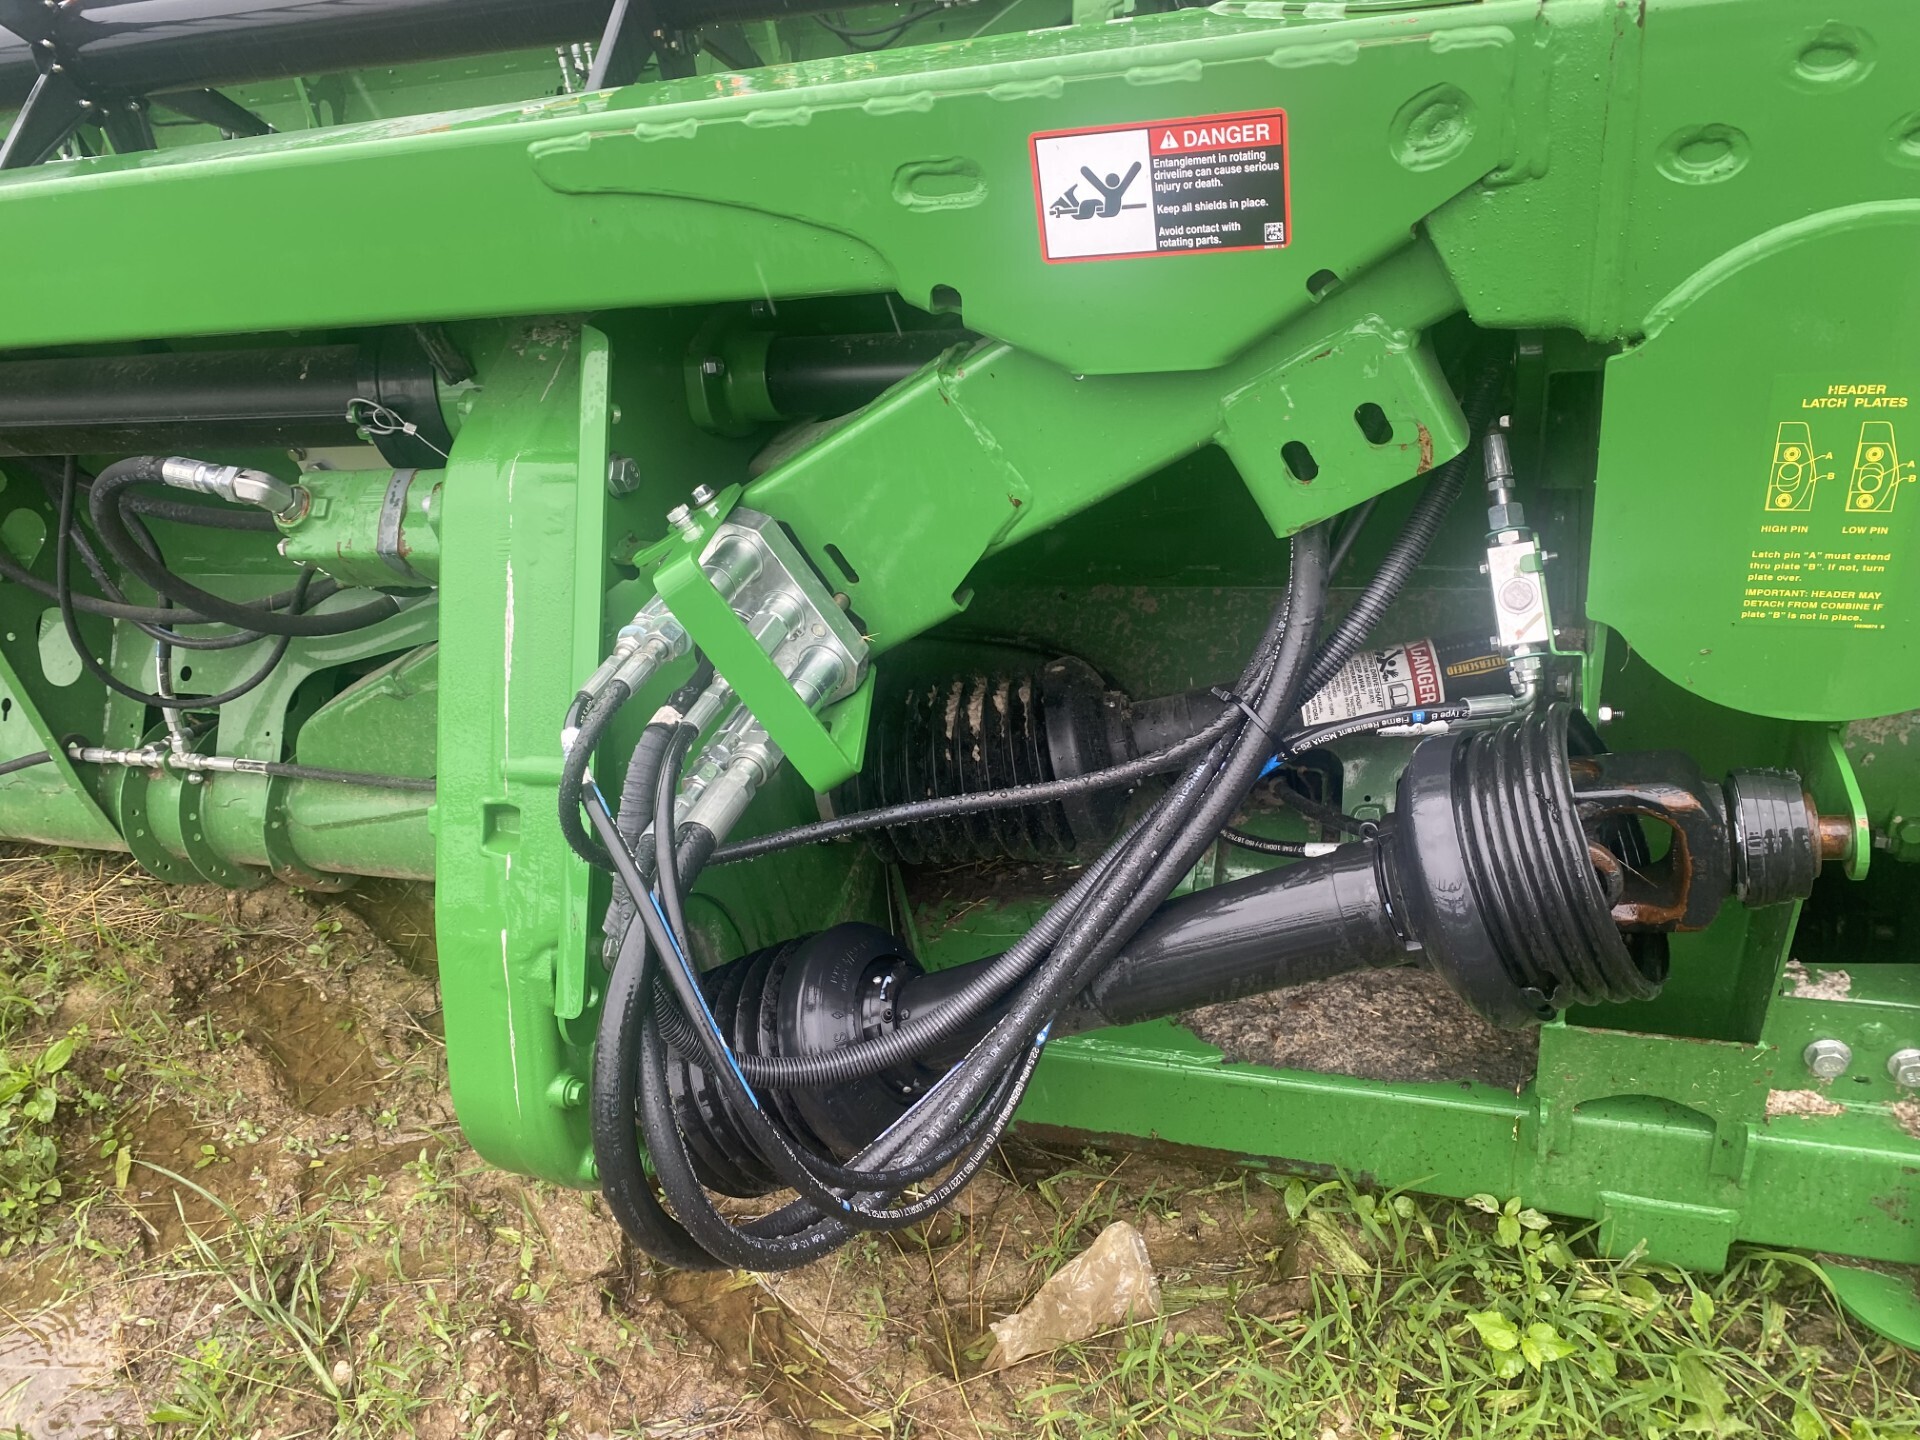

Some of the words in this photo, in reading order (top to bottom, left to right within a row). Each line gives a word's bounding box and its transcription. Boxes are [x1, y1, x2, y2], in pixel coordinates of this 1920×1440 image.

[1184, 124, 1269, 148] DANGER
[1154, 154, 1216, 168] Entanglement
[1218, 153, 1227, 162] in
[1230, 150, 1266, 163] rotating
[1154, 167, 1193, 180] driveline
[1196, 167, 1212, 176] can
[1214, 165, 1242, 175] cause
[1244, 162, 1279, 172] serious
[1155, 181, 1181, 193] injury
[1184, 181, 1192, 189] or
[1195, 178, 1223, 189] death.
[1157, 204, 1180, 216] Keep
[1182, 202, 1192, 212] all
[1195, 200, 1227, 211] shields
[1230, 200, 1239, 209] in
[1241, 198, 1268, 210] place.
[1159, 225, 1184, 236] Avoid
[1186, 224, 1219, 234] contact
[1221, 222, 1241, 232] with
[1160, 236, 1193, 249] rotating
[1196, 235, 1221, 247] parts.
[1828, 385, 1886, 395] HEADER
[1802, 398, 1847, 408] LATCH
[1854, 398, 1908, 408] PLATES
[1825, 452, 1833, 460] A
[1751, 550, 1780, 559] Latch
[1784, 551, 1800, 560] pin
[1825, 552, 1851, 560] must
[1854, 553, 1890, 561] extend
[1774, 562, 1800, 572] plate
[1838, 564, 1859, 572] not,
[1748, 573, 1773, 583] plate
[1745, 589, 1808, 598] IMPORTANT:
[1811, 590, 1855, 599] HEADER
[1858, 591, 1882, 600] MAY
[1743, 600, 1784, 608] DETACH
[1787, 601, 1818, 609] FROM
[1820, 602, 1870, 610] COMBINE
[1872, 603, 1884, 611] IF
[1741, 611, 1766, 620] plate
[1819, 613, 1828, 621] in
[1831, 613, 1862, 622] place.
[1370, 668, 1383, 708] DRIVESHAFT
[1440, 709, 1460, 718] Type
[1382, 717, 1409, 725] Flame
[1340, 721, 1380, 736] Resistant
[1312, 733, 1337, 745] MSHA
[1029, 1047, 1040, 1066] 22.5
[1020, 1065, 1033, 1082] MPa
[929, 1121, 943, 1138] R17
[964, 1162, 974, 1175] ISO
[949, 1170, 968, 1189] 11237
[940, 1183, 954, 1199] R17
[924, 1195, 937, 1208] SAE
